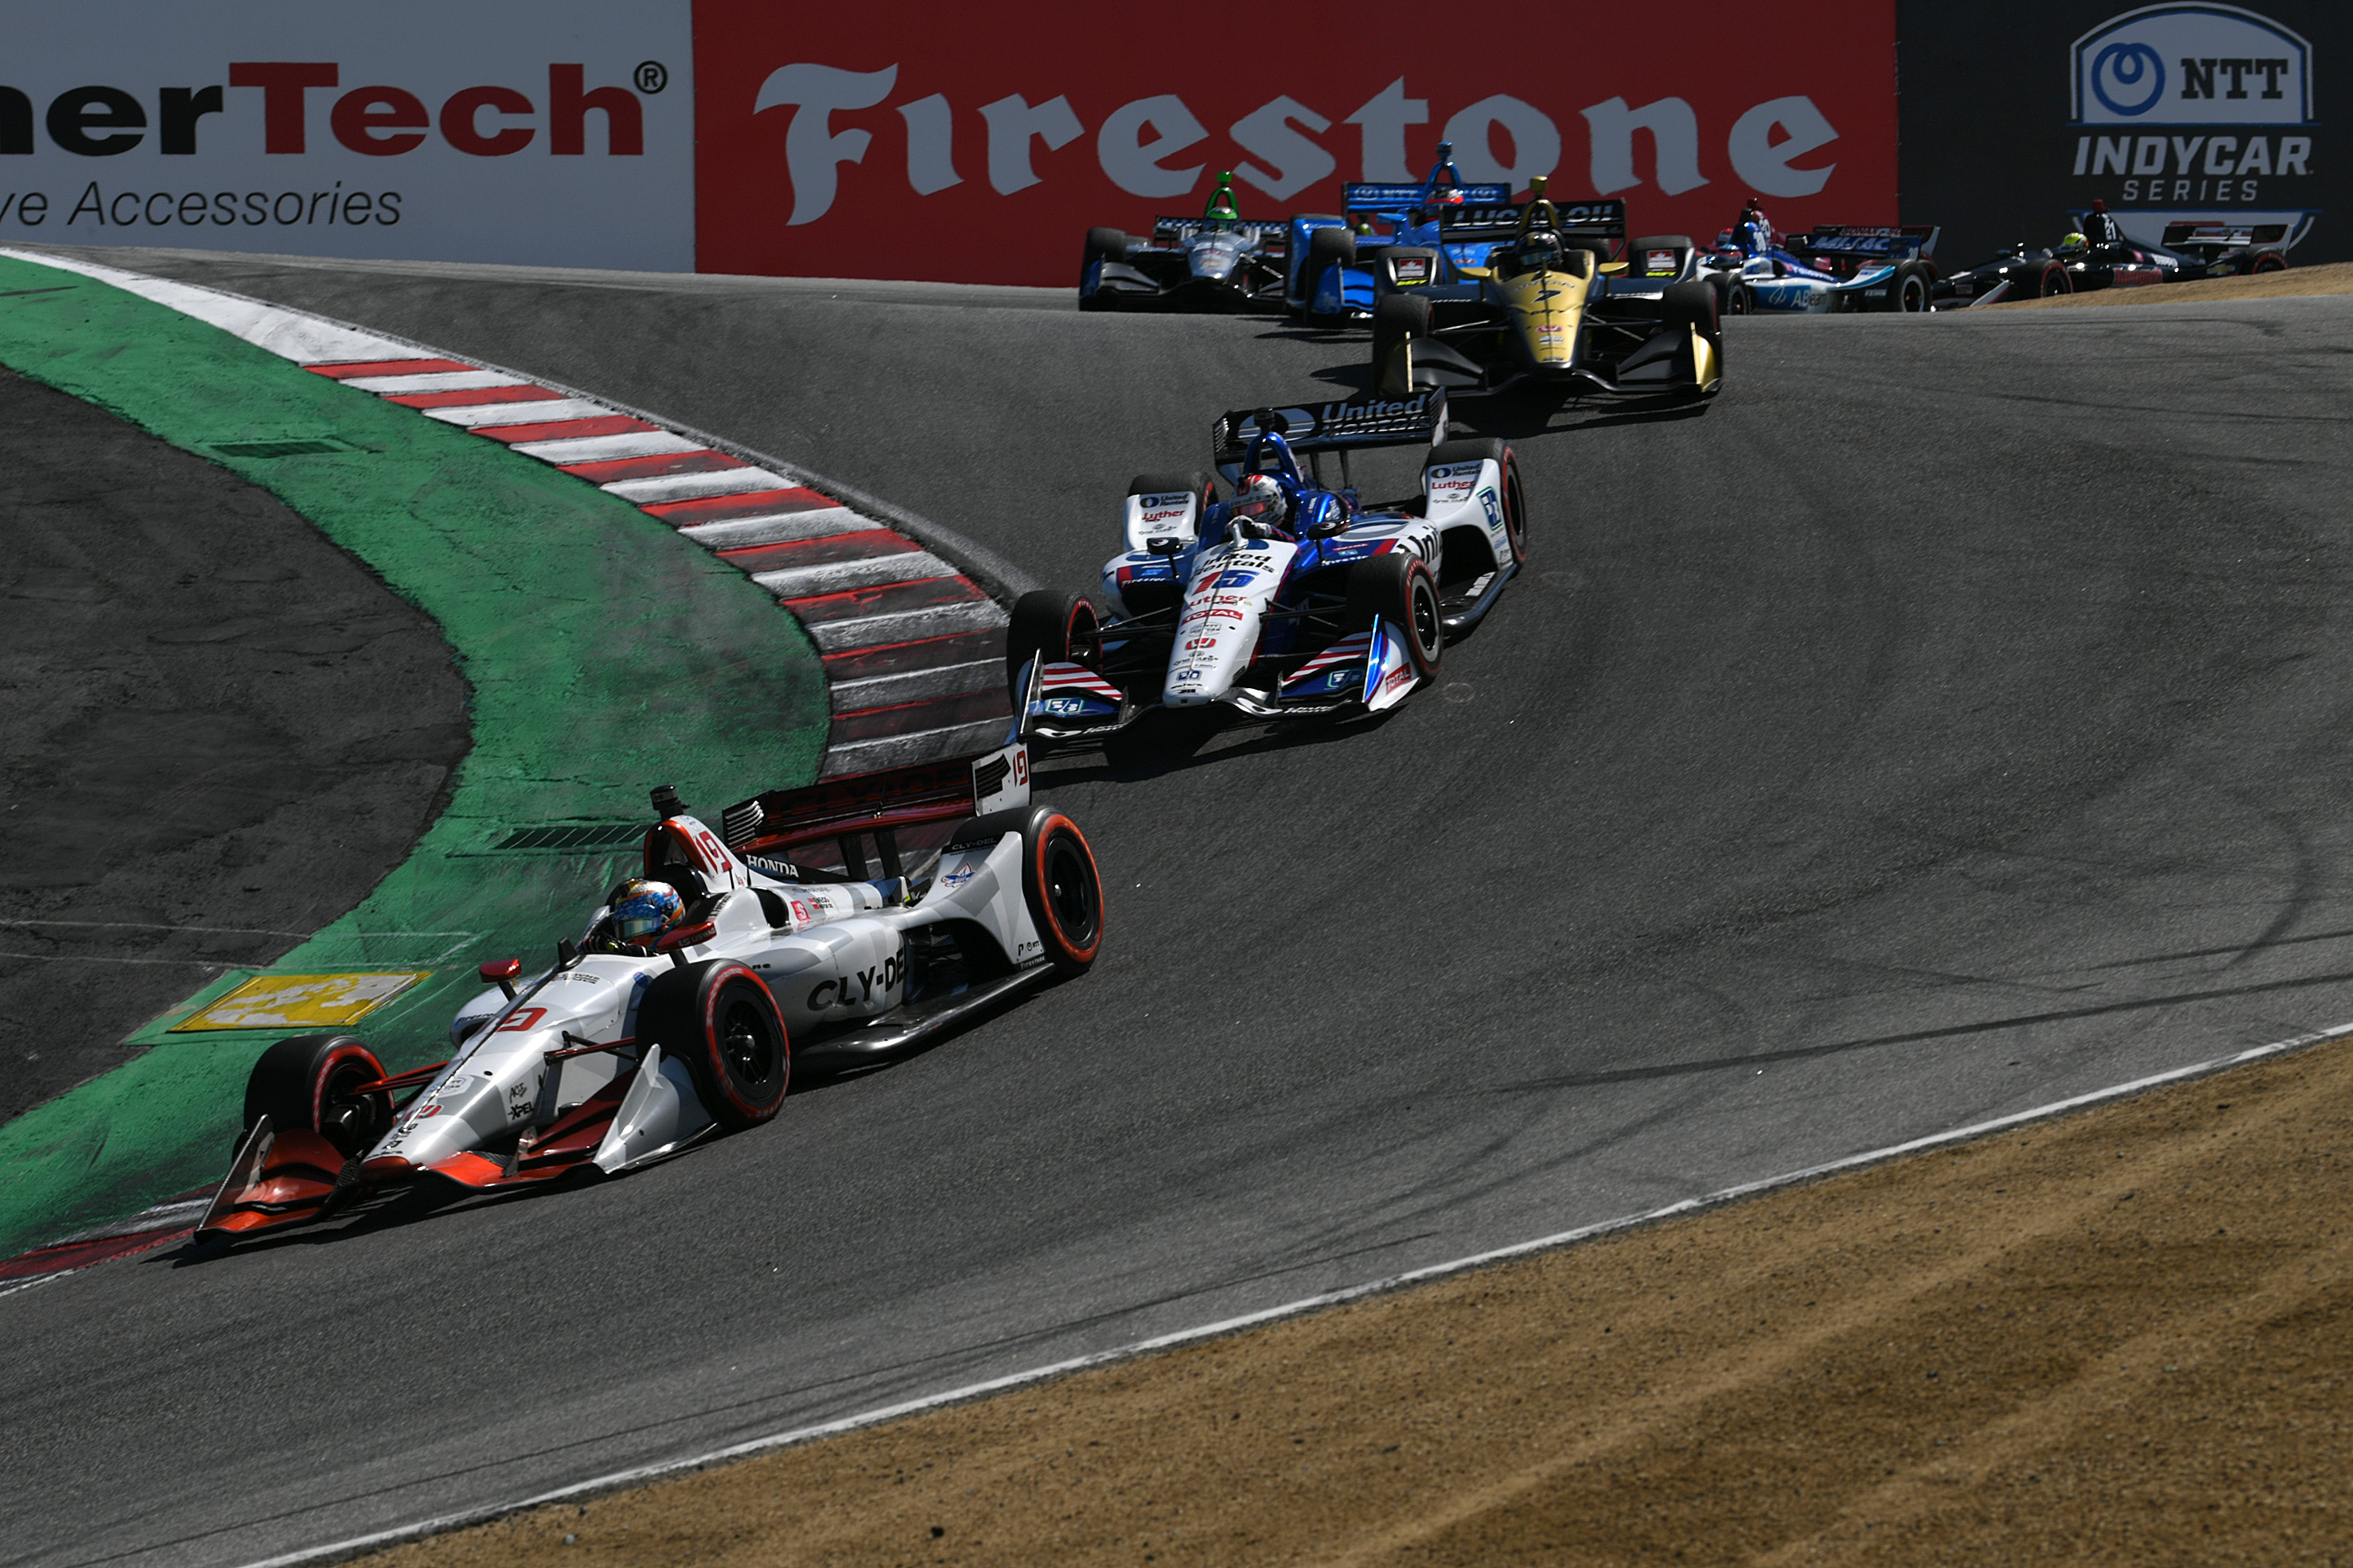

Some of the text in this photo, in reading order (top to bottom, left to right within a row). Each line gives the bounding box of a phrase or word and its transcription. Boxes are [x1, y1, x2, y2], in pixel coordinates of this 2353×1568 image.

[2180, 58, 2289, 99] NTT
[754, 62, 1839, 226] Firestone
[2073, 136, 2312, 176] INDYCAR
[66, 181, 403, 226] Accessories
[2122, 180, 2258, 201] SERIES
[1322, 394, 1427, 423] United
[1387, 670, 1411, 691] TOTAL
[952, 838, 997, 850] CLY-DEL
[746, 854, 800, 877] HONDA
[508, 1101, 535, 1120] XPEL
